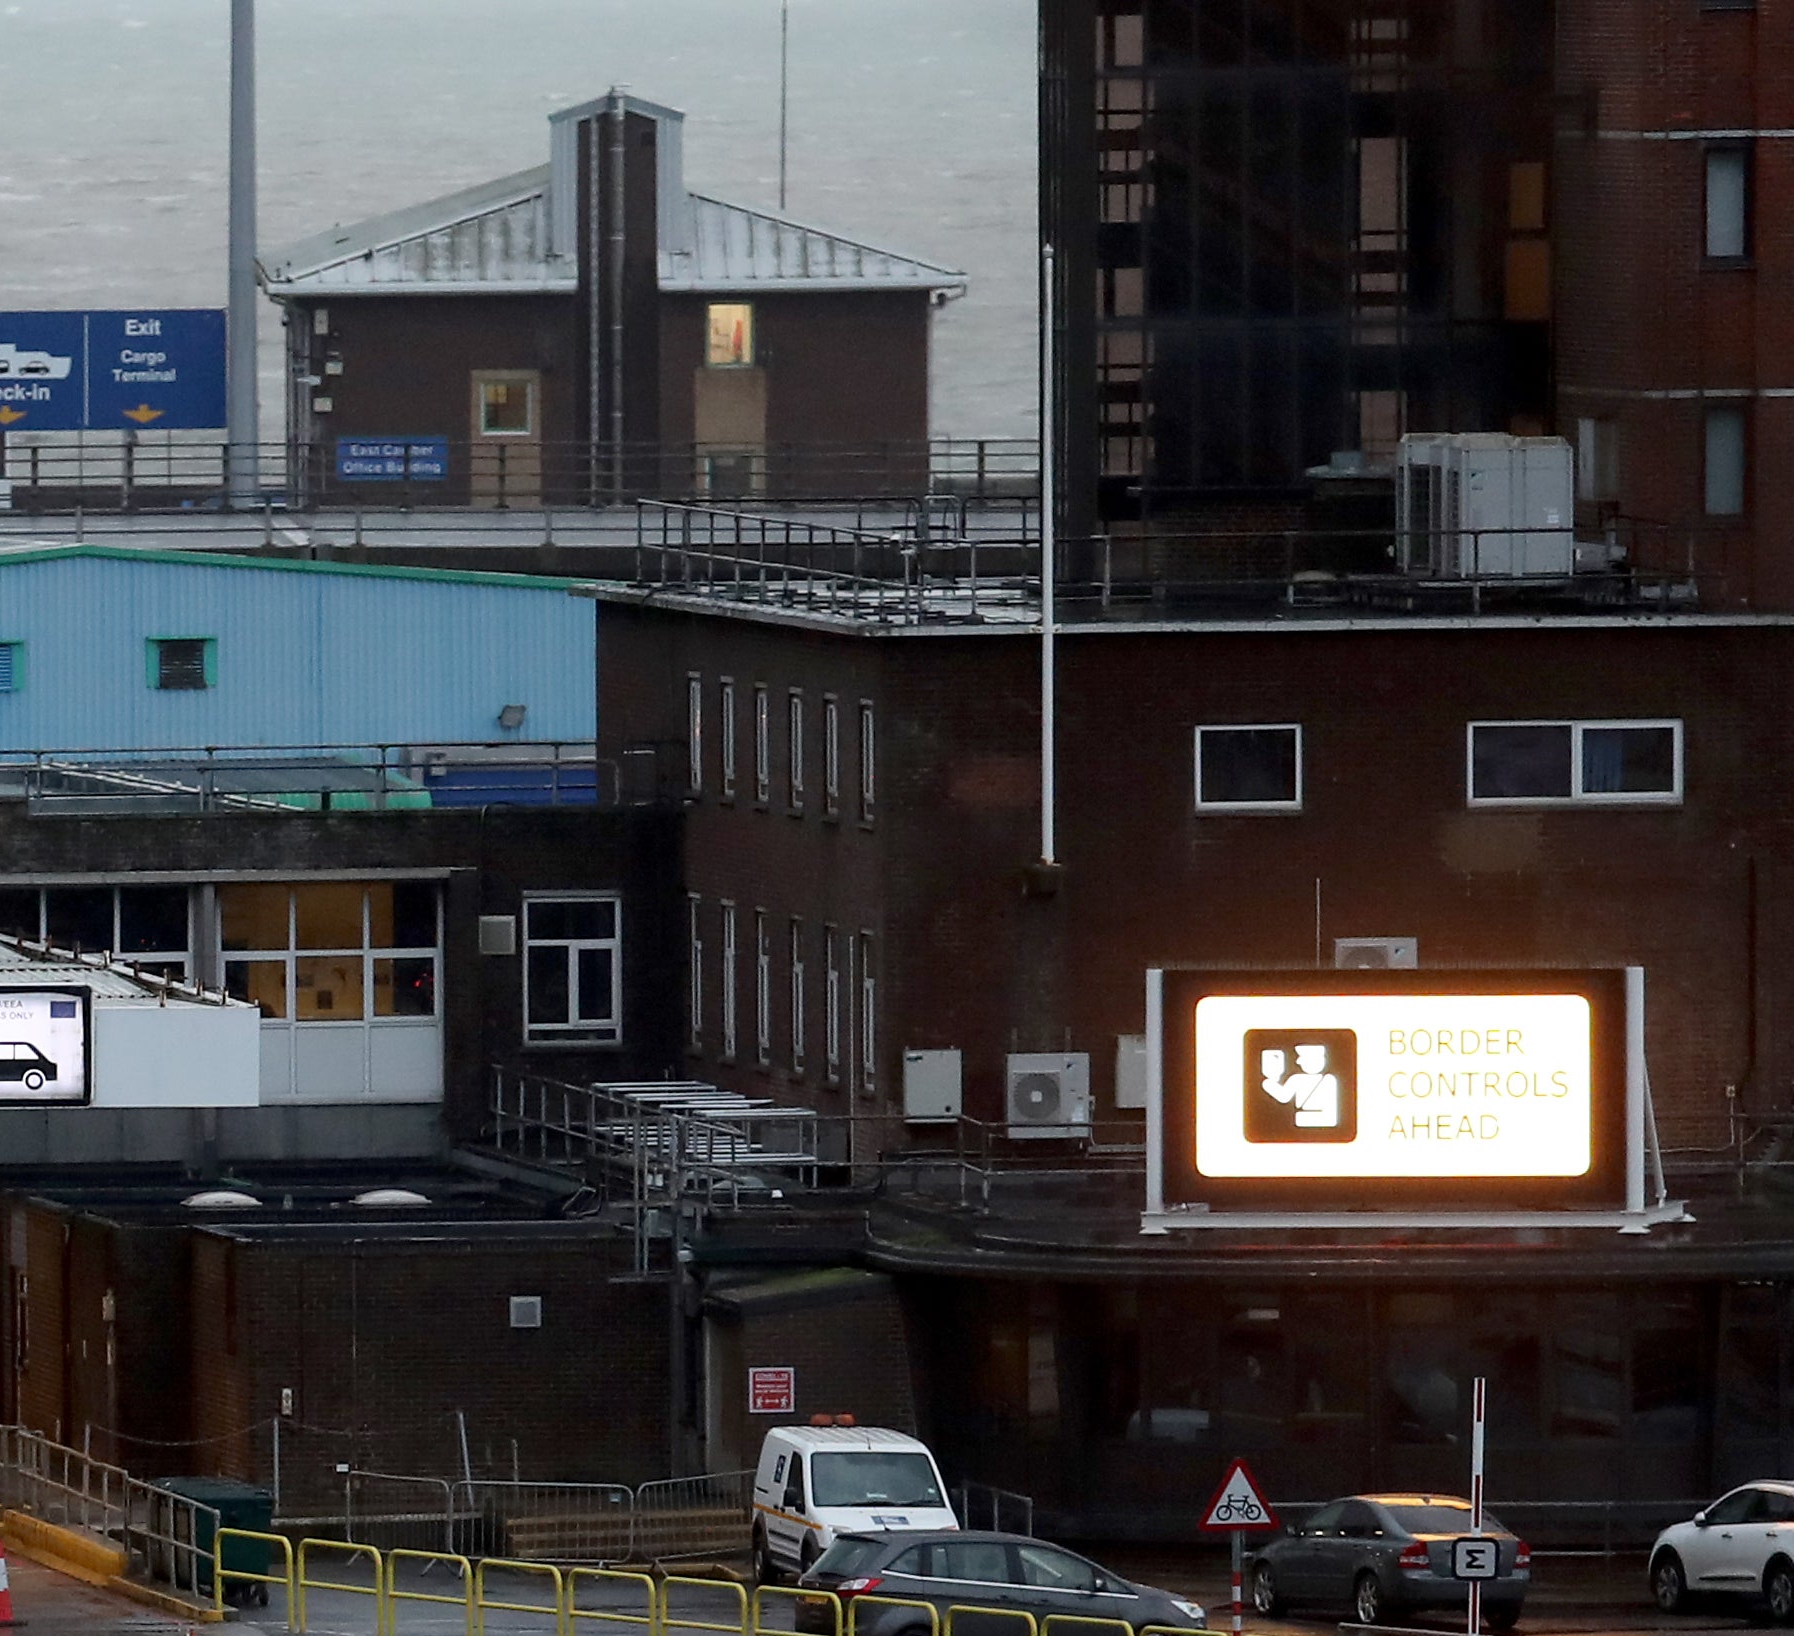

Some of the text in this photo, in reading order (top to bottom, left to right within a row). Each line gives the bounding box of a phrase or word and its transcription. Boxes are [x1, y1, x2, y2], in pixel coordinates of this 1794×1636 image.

[125, 319, 161, 337] Exit
[121, 350, 167, 366] Cargo
[112, 368, 176, 383] Terminal
[8, 1010, 35, 1020] ONLY
[1389, 1028, 1525, 1055] BORDER
[1388, 1071, 1569, 1098] CONTROLS
[1388, 1114, 1500, 1140] AHEAD
